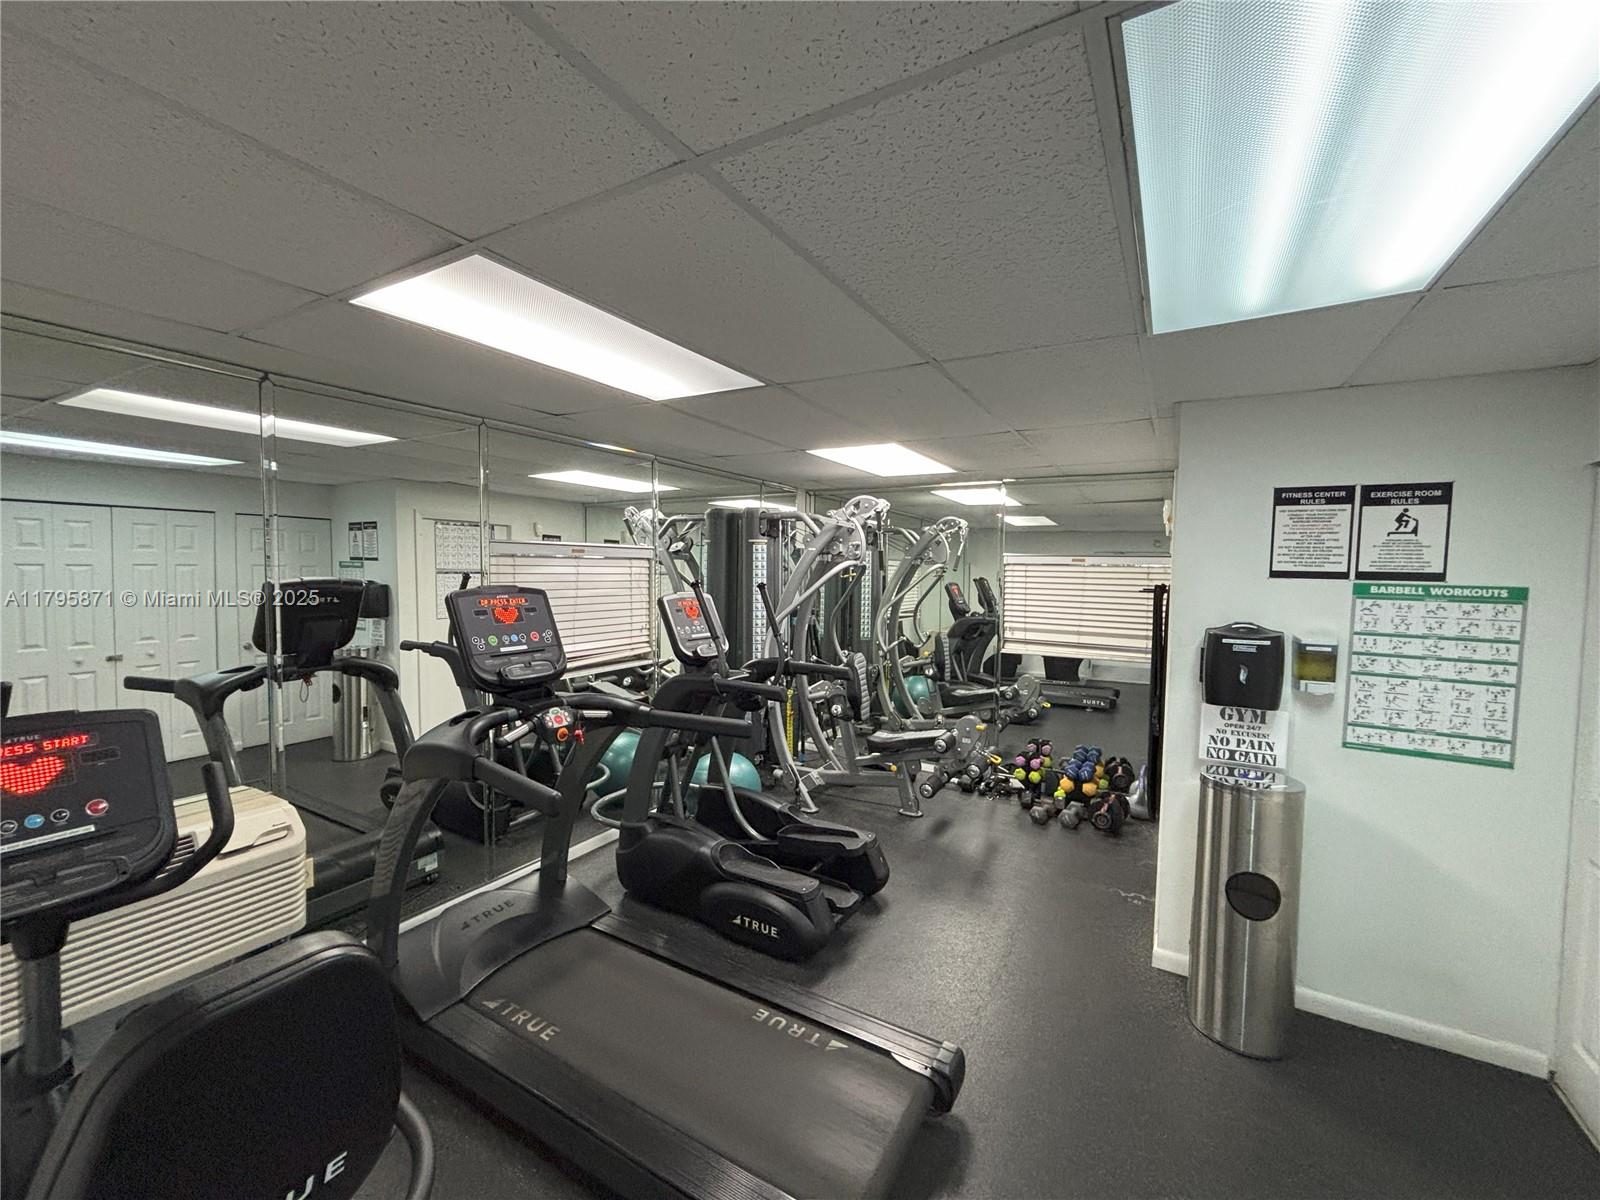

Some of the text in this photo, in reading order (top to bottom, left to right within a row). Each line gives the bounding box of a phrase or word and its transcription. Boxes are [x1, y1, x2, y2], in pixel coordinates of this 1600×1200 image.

[1281, 490, 1347, 499] FITNESS CENTER
[1370, 489, 1443, 498] EXERCISE ROOM
[1370, 585, 1509, 599] BARBELL WORKOUTS
[1220, 706, 1267, 724] GYM
[43, 735, 88, 750] START
[1231, 730, 1270, 739] EXCUSES!
[1208, 735, 1275, 752] NO PAIN
[1207, 747, 1277, 767] NO GAIN
[471, 898, 516, 924] TRUE
[744, 916, 780, 938] TRUE
[499, 1003, 561, 1043] TRUE
[752, 1007, 826, 1047] TRUE
